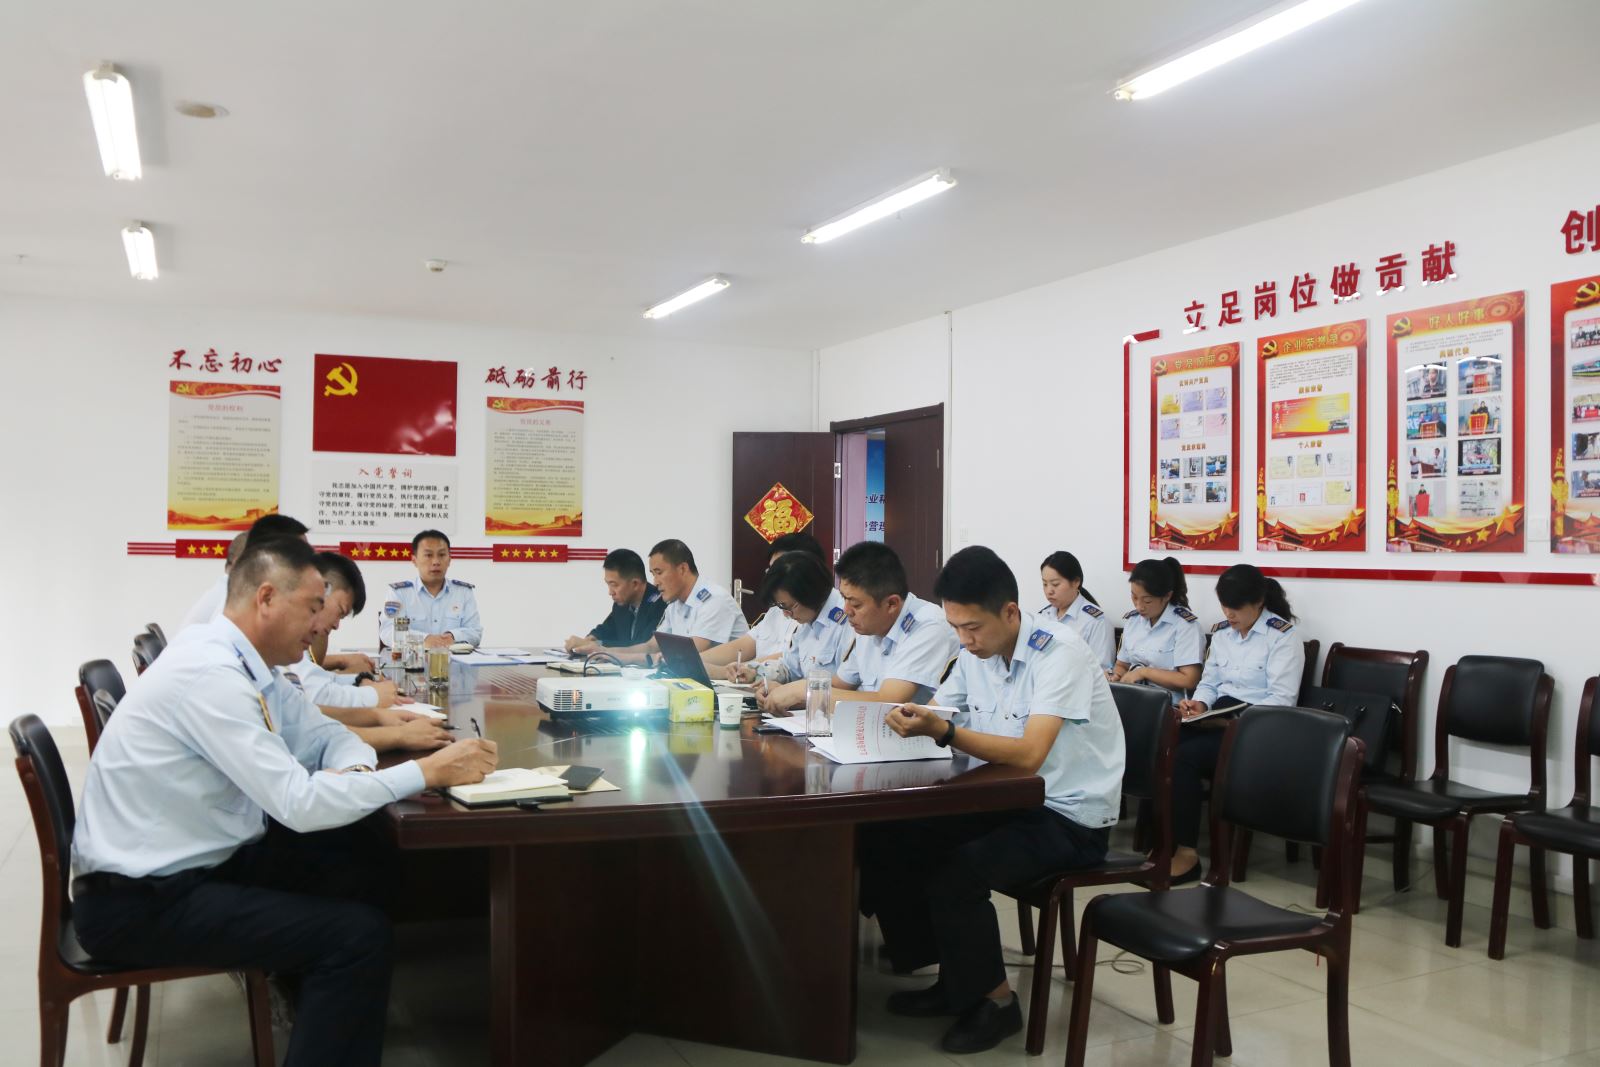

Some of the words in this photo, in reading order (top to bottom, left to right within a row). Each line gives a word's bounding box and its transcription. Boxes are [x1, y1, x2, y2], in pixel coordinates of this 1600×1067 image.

[1560, 204, 1600, 254] 创
[1183, 240, 1457, 334] 立足岗位做贡献
[1429, 307, 1485, 329] 好人好事
[169, 348, 282, 373] 不忘初心
[485, 366, 587, 392] 砥砺前行
[359, 466, 412, 479] 入党誓词
